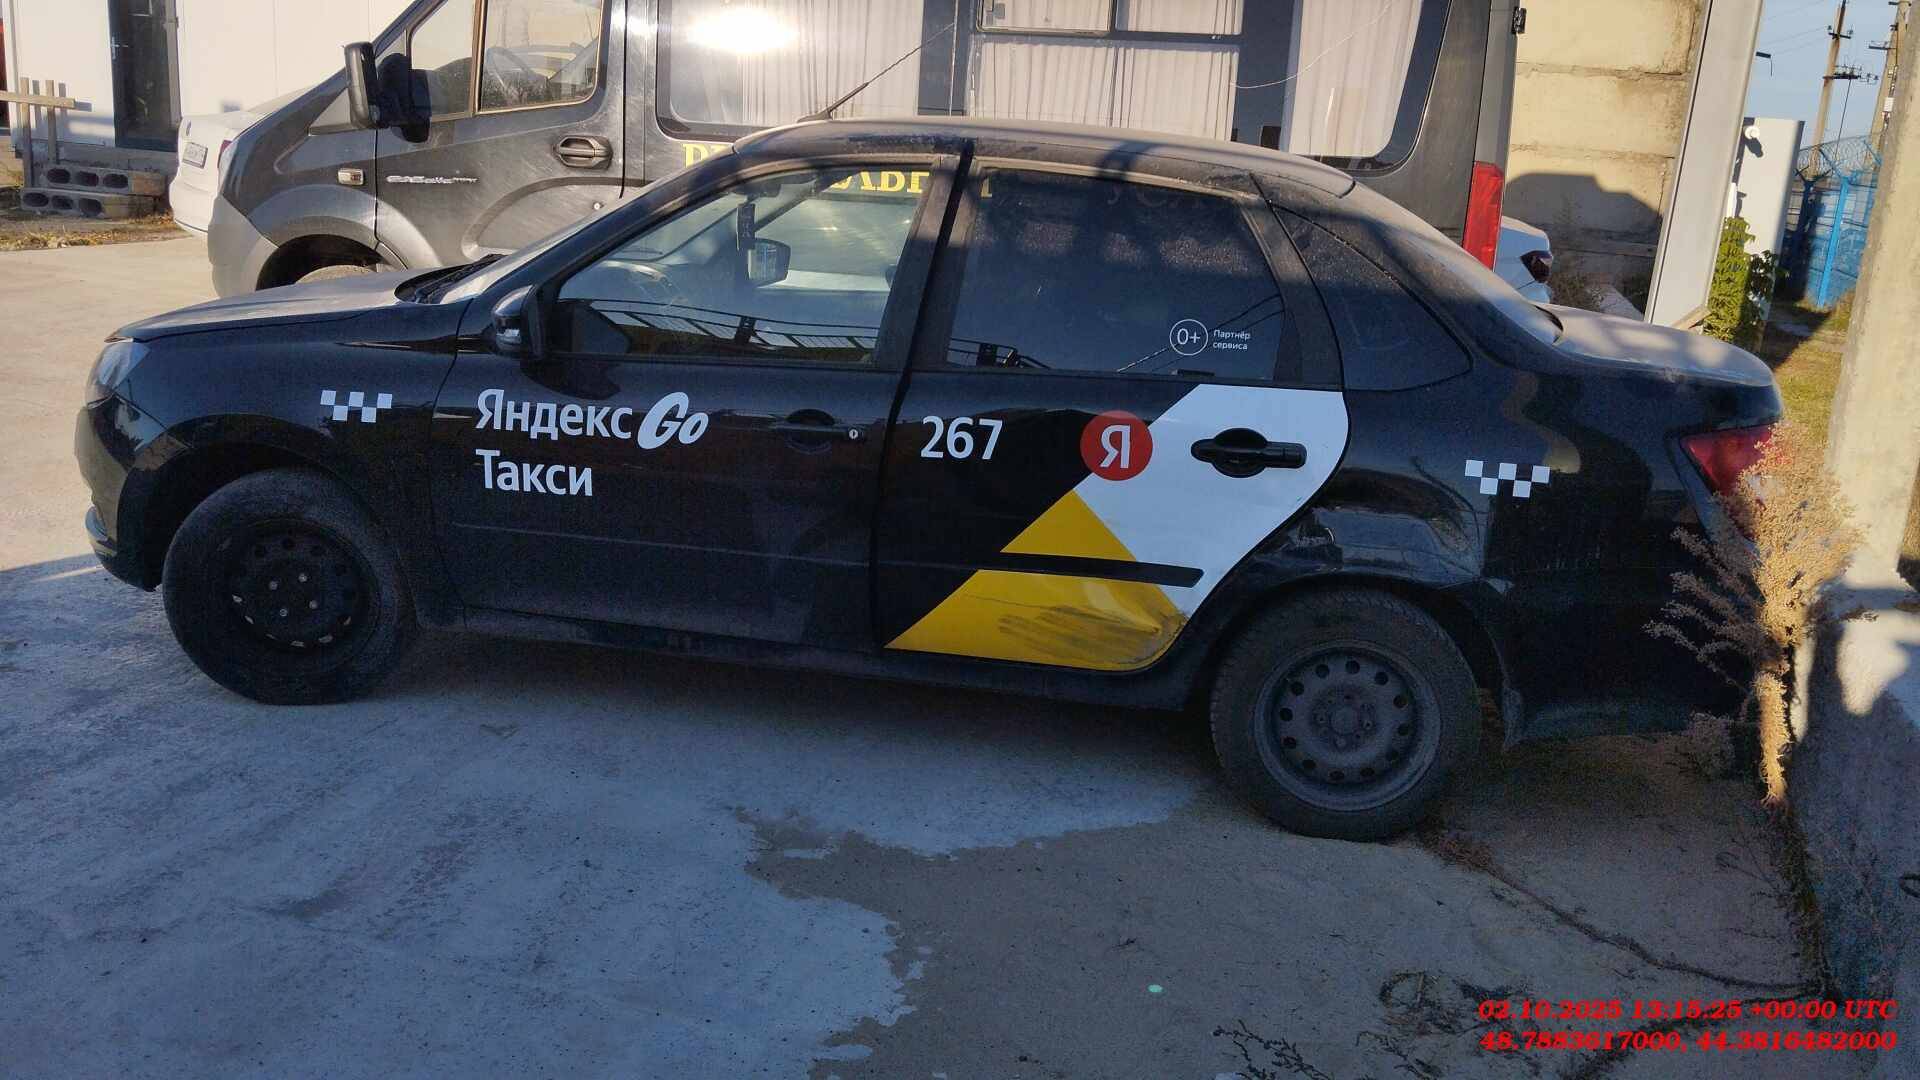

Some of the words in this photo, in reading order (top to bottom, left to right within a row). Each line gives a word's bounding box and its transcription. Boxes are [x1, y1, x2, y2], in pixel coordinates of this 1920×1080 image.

[1177, 328, 1201, 345] 0+
[1213, 329, 1251, 341] Партнёр
[1213, 341, 1248, 350] сервиса
[475, 388, 633, 441] Яндекс
[637, 391, 709, 450] Go
[921, 415, 1003, 460] 267
[1100, 424, 1131, 469] Я
[475, 449, 593, 496] Такси
